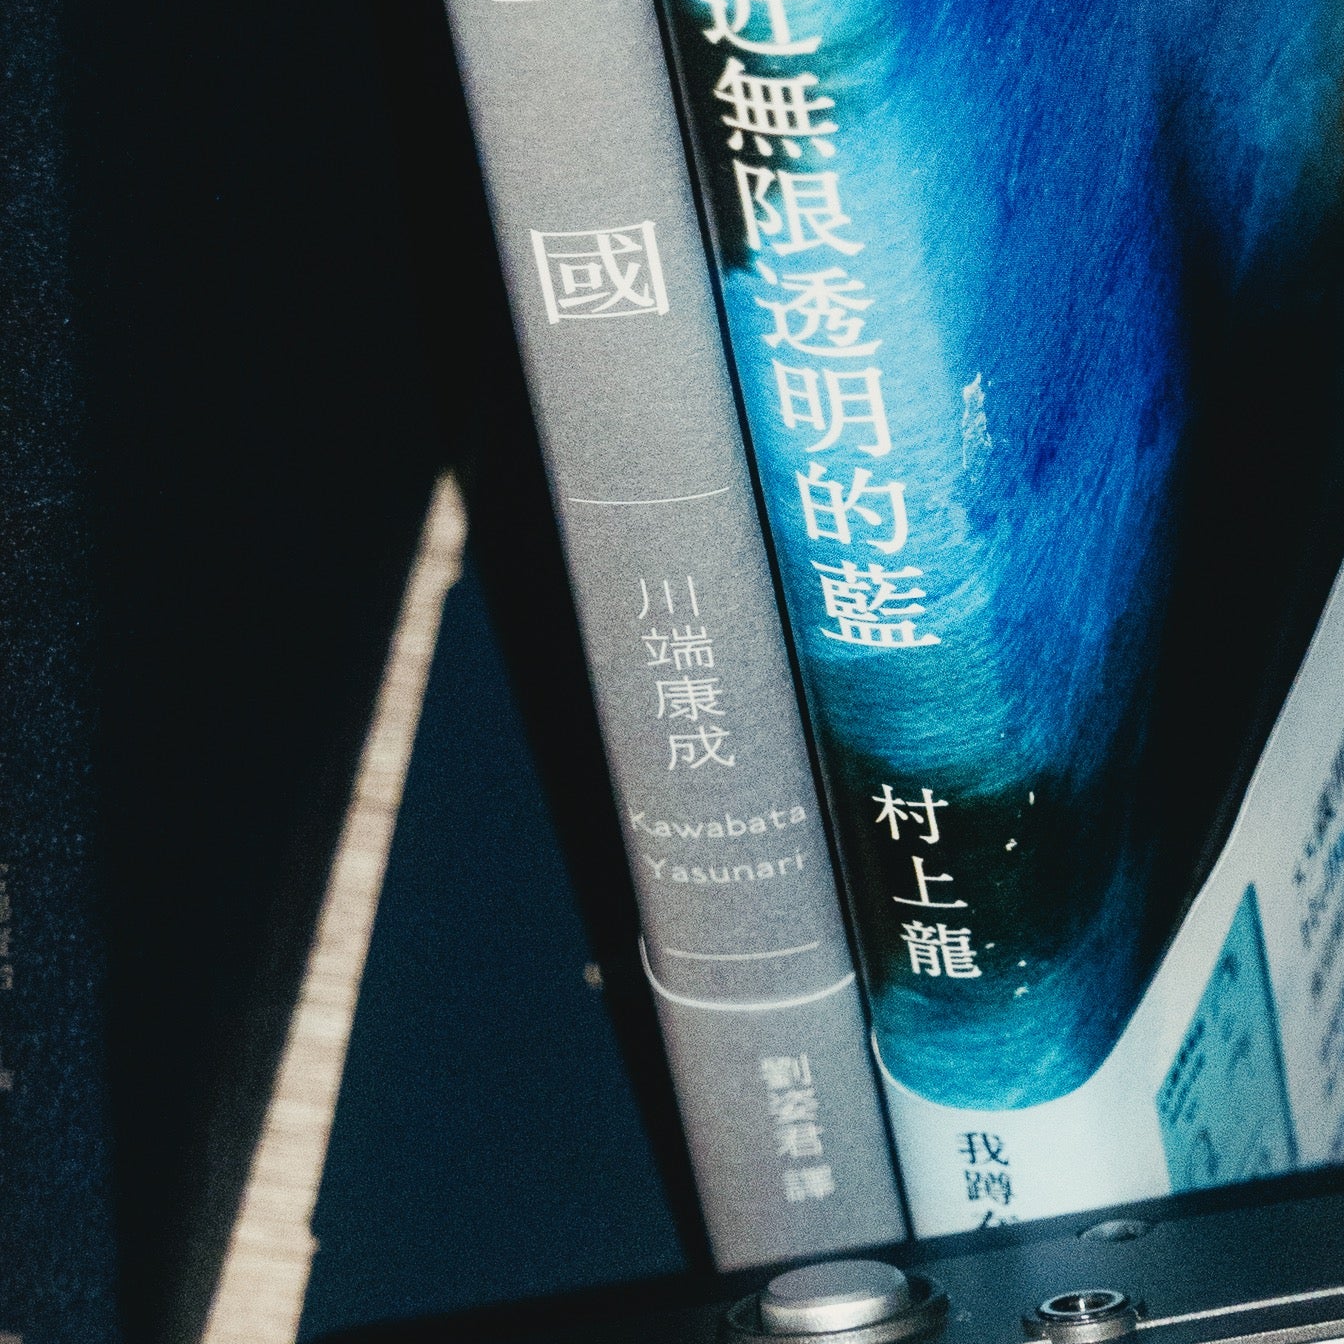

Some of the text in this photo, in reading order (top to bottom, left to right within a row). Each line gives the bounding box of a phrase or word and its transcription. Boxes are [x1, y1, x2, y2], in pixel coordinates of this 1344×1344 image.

[639, 575, 736, 770] 川端康成
[629, 804, 808, 838] Kawabata
[643, 850, 805, 883] Yasunari
[871, 783, 983, 979] 村上龍
